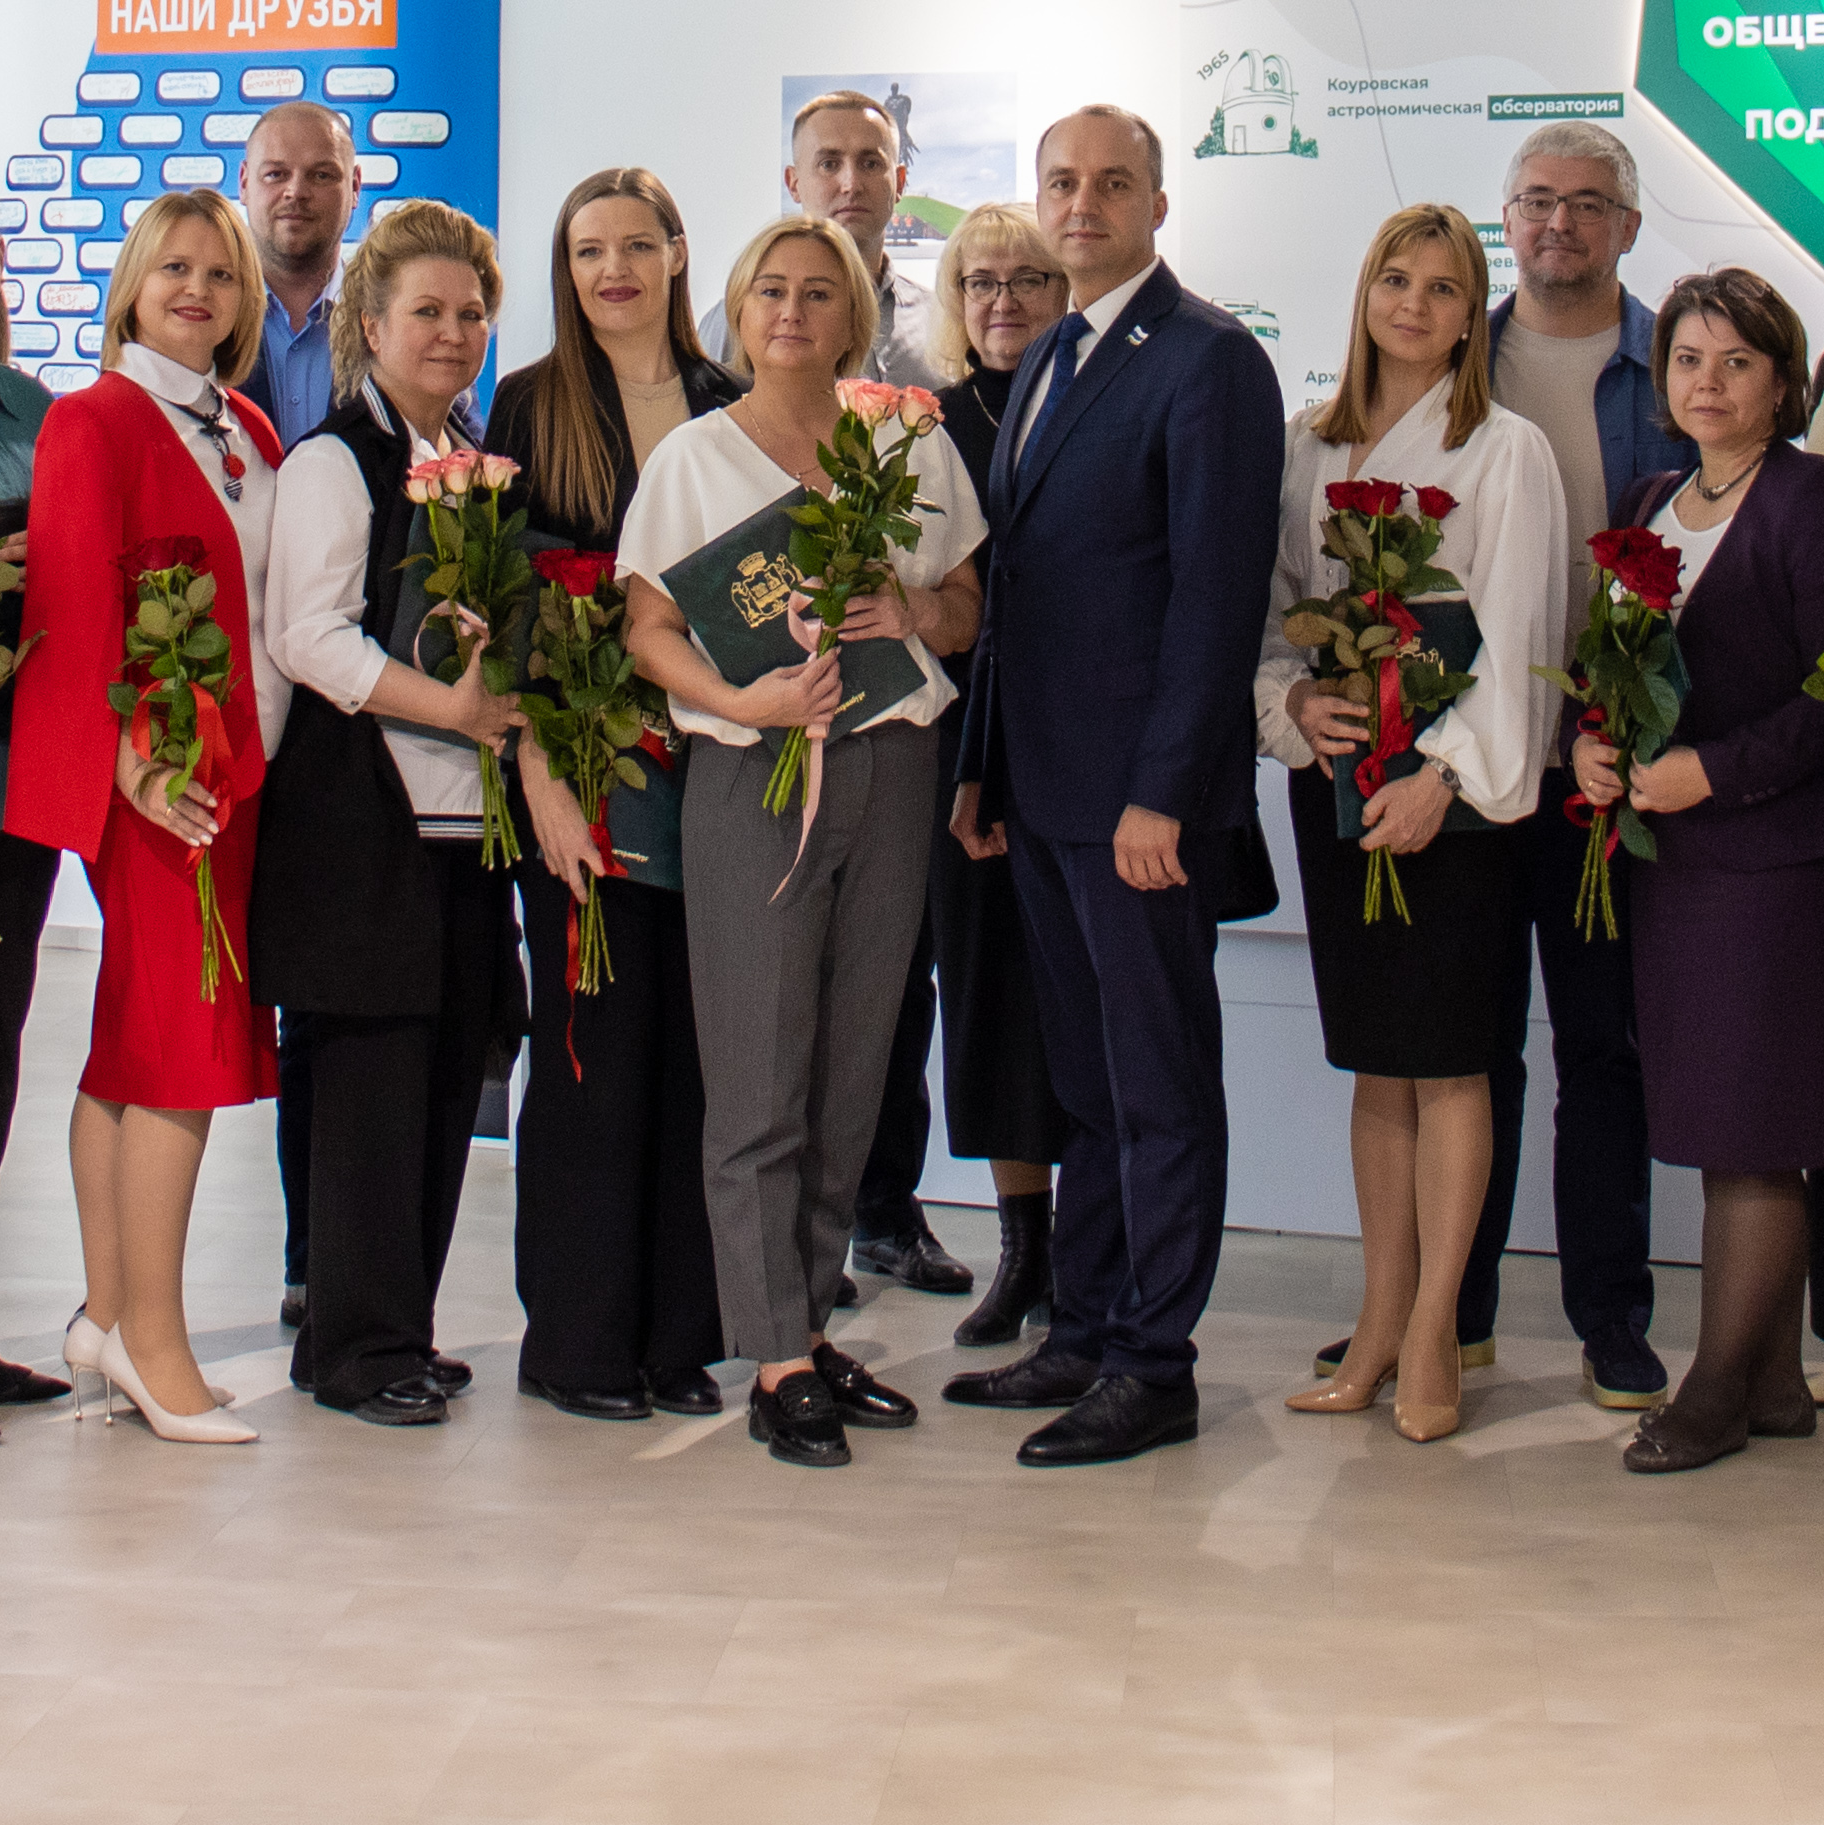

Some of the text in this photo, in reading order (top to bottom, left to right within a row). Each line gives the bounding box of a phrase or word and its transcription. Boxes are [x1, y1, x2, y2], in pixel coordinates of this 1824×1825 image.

[1196, 49, 1231, 81] 1965
[1327, 76, 1429, 94] Коуровская
[1327, 97, 1620, 119] астрономическая обсерватория
